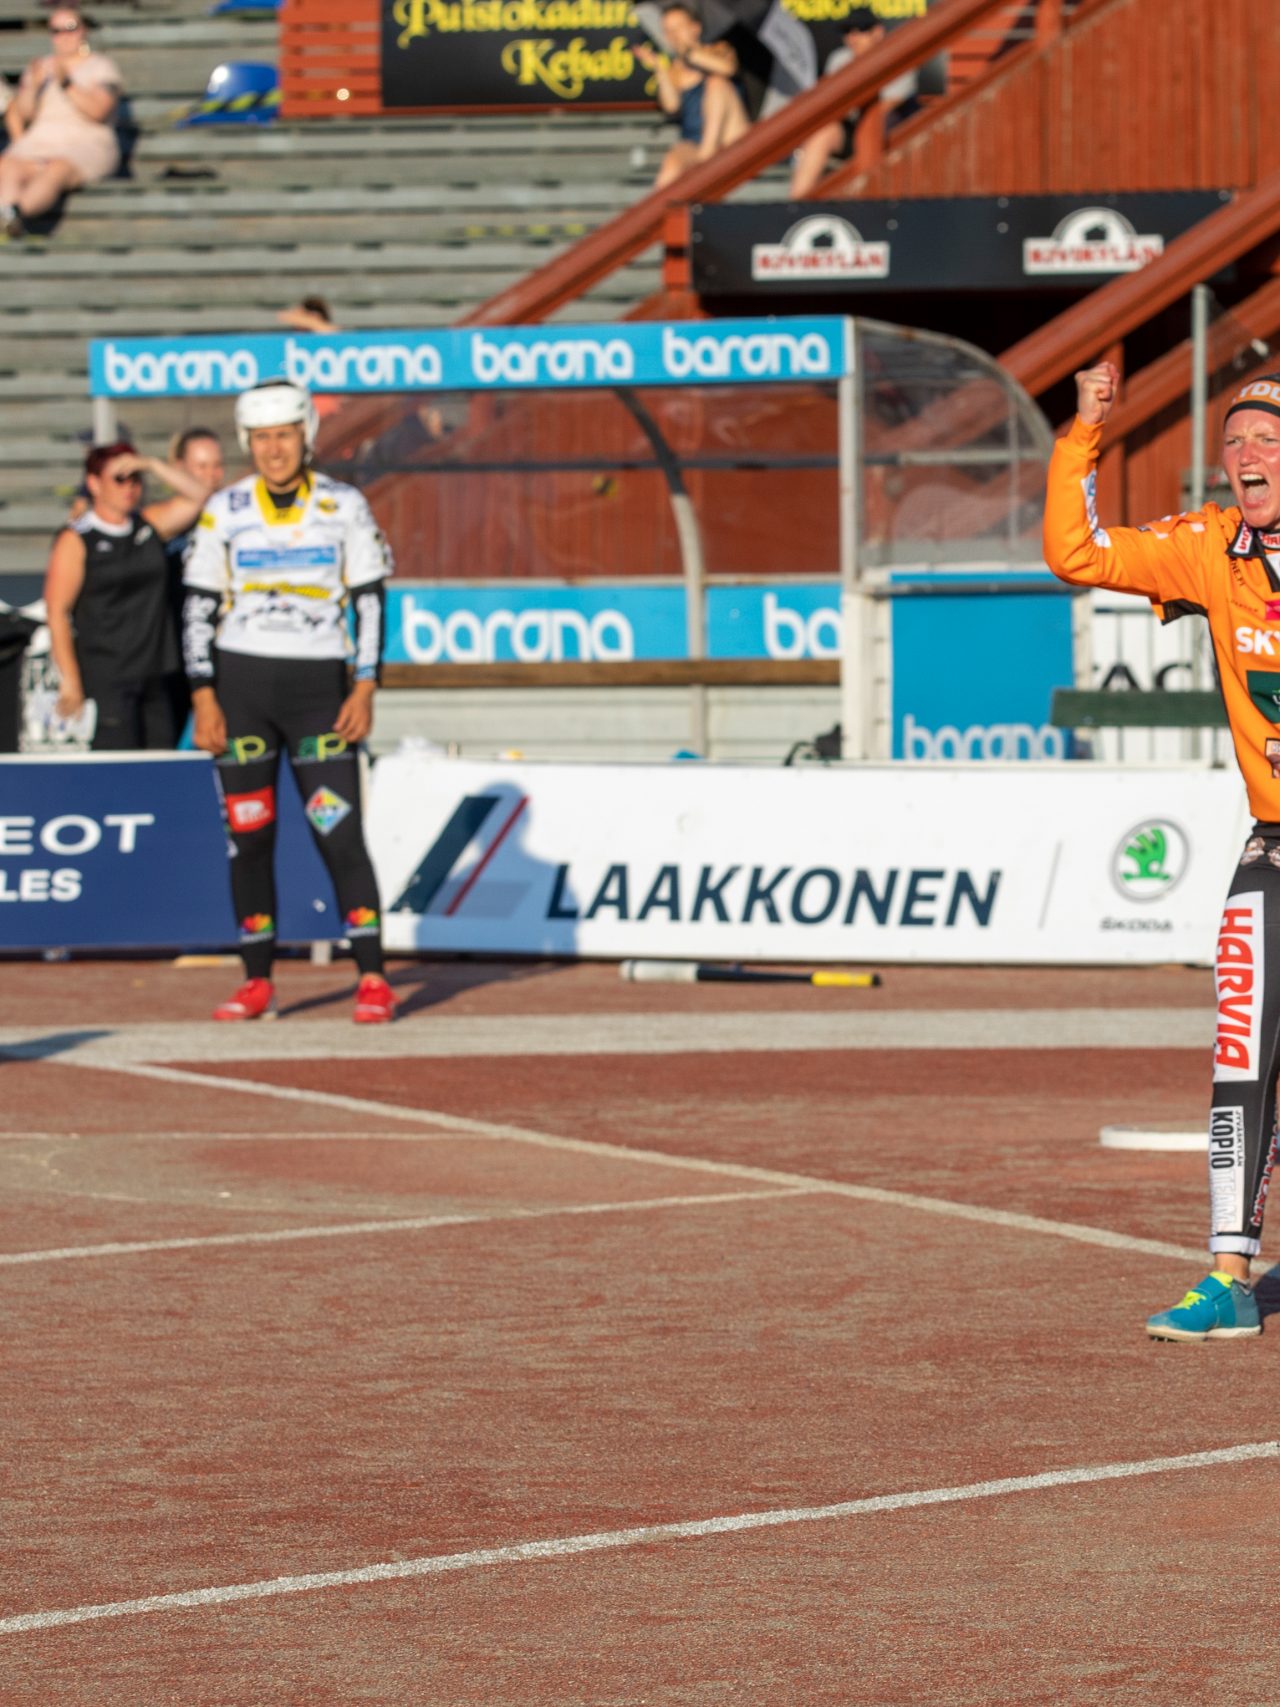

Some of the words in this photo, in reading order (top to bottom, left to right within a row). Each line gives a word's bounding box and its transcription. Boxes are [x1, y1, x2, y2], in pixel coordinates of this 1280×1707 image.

[501, 37, 635, 98] Kebab
[104, 343, 257, 393] barona
[284, 339, 442, 387] barona
[471, 333, 634, 382] barona
[662, 328, 830, 378] barona
[402, 594, 634, 664] barona
[544, 862, 1002, 928] LAAKKONEN
[1214, 907, 1254, 1072] HARVIA
